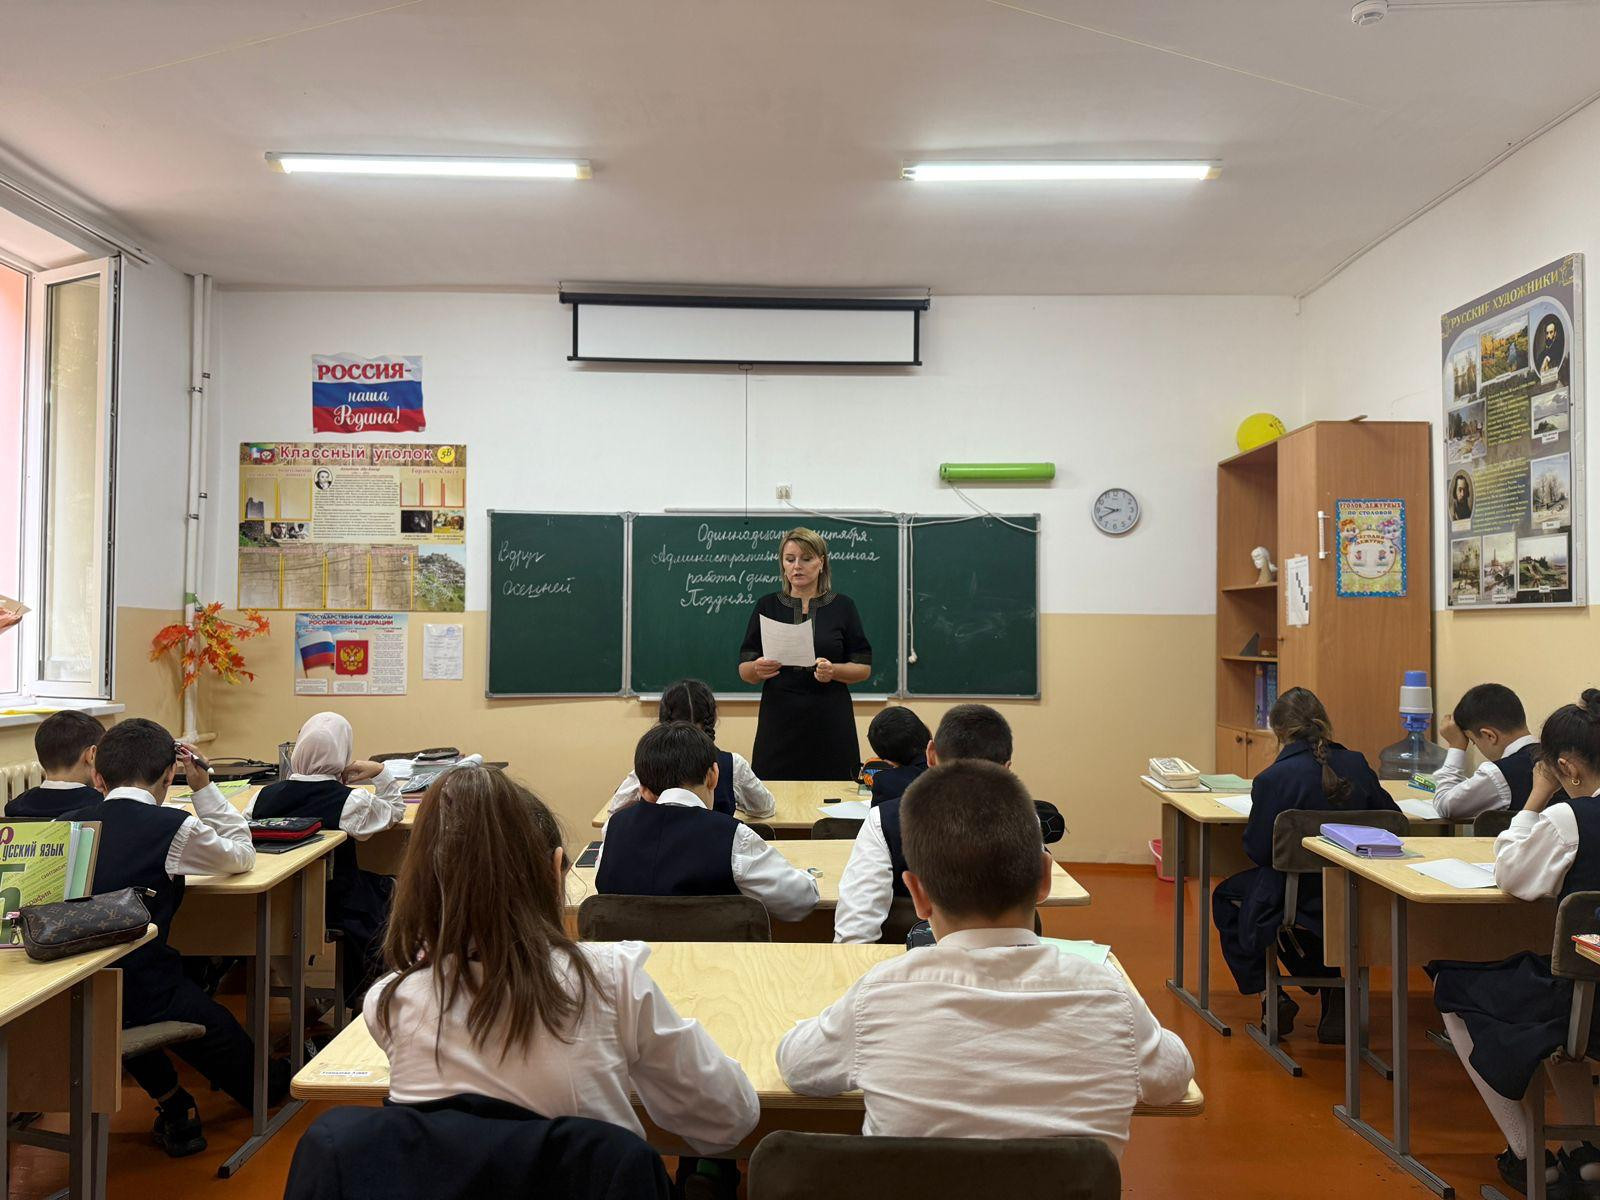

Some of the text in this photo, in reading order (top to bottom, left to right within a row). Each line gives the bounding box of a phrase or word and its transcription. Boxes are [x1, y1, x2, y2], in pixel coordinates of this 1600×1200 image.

[1450, 270, 1559, 329] РУССКИЕ ХУДОЖНИКИ
[317, 363, 412, 381] РОССИЯ-
[348, 391, 389, 403] наша
[333, 404, 400, 431] Родина!
[280, 445, 433, 462] Классный уголок
[697, 523, 788, 550] Одиннадцат
[651, 544, 881, 571] Административн рольная
[685, 569, 783, 592] работа (дикт
[680, 588, 756, 614] Поздняя
[39, 843, 65, 857] язык
